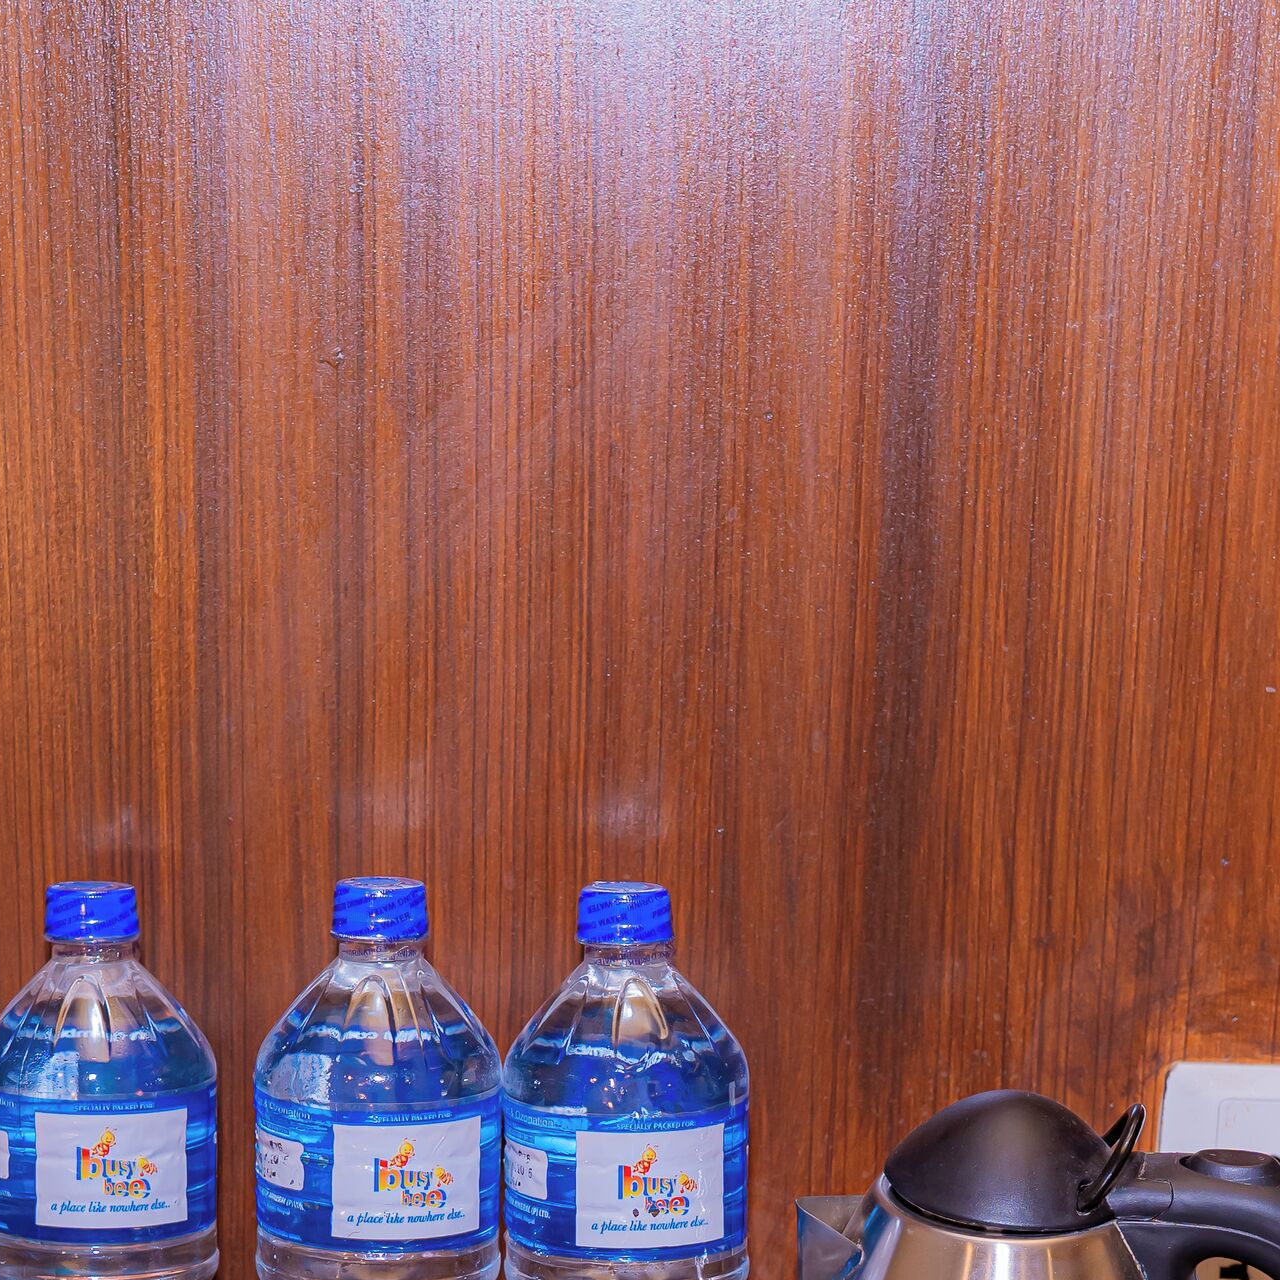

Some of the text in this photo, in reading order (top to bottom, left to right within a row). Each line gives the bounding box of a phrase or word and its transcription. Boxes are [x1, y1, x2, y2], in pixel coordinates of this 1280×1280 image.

[616, 1122, 652, 1130] SPECIALLY
[654, 1121, 680, 1130] PACKED
[76, 1146, 135, 1180] busy
[374, 1158, 433, 1192] busy
[618, 1165, 677, 1199] busy
[103, 1177, 151, 1199] bee
[51, 1202, 58, 1211] a
[59, 1201, 86, 1214] place
[89, 1200, 107, 1212] like
[110, 1200, 149, 1213] nowhere
[401, 1189, 447, 1208] bee
[644, 1196, 690, 1216] bee
[347, 1214, 354, 1222] a
[356, 1212, 383, 1226] place
[386, 1211, 404, 1223] like
[407, 1211, 445, 1223] nowhere
[591, 1222, 598, 1230] a
[600, 1220, 627, 1234] place
[629, 1220, 647, 1231] like
[650, 1218, 689, 1231] nowhere
